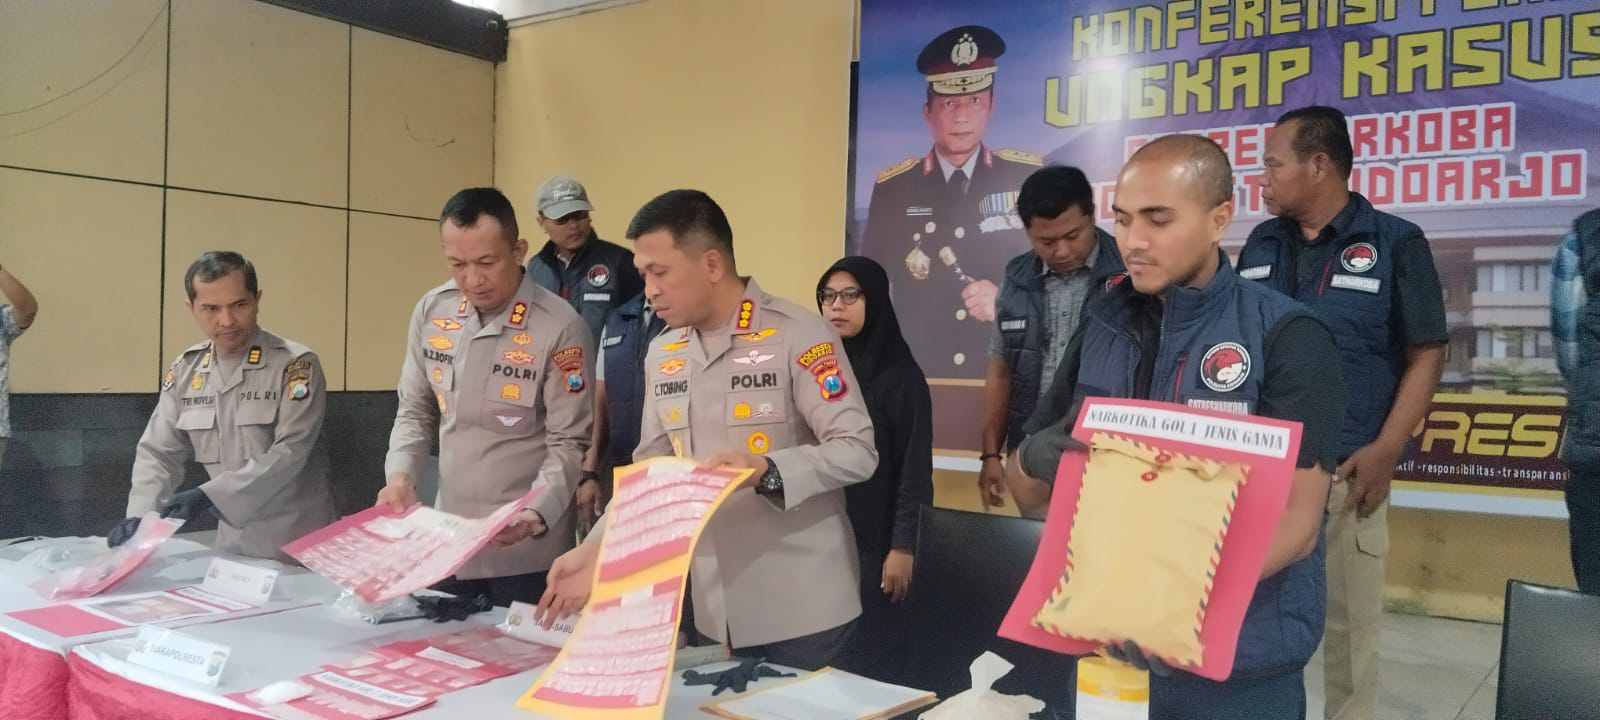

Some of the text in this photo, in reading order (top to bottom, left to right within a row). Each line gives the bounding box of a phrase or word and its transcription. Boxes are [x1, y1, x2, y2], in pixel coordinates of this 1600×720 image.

[1044, 10, 1600, 128] UNGKAP KASUS
[1351, 152, 1583, 206] IDOARJO
[492, 364, 537, 382] POLRI
[730, 372, 777, 390] POLRI
[1088, 408, 1158, 431] NARKOTIKA
[1161, 418, 1187, 433] GOL
[1203, 423, 1240, 441] JENIS
[1422, 463, 1495, 477] responsibilitas
